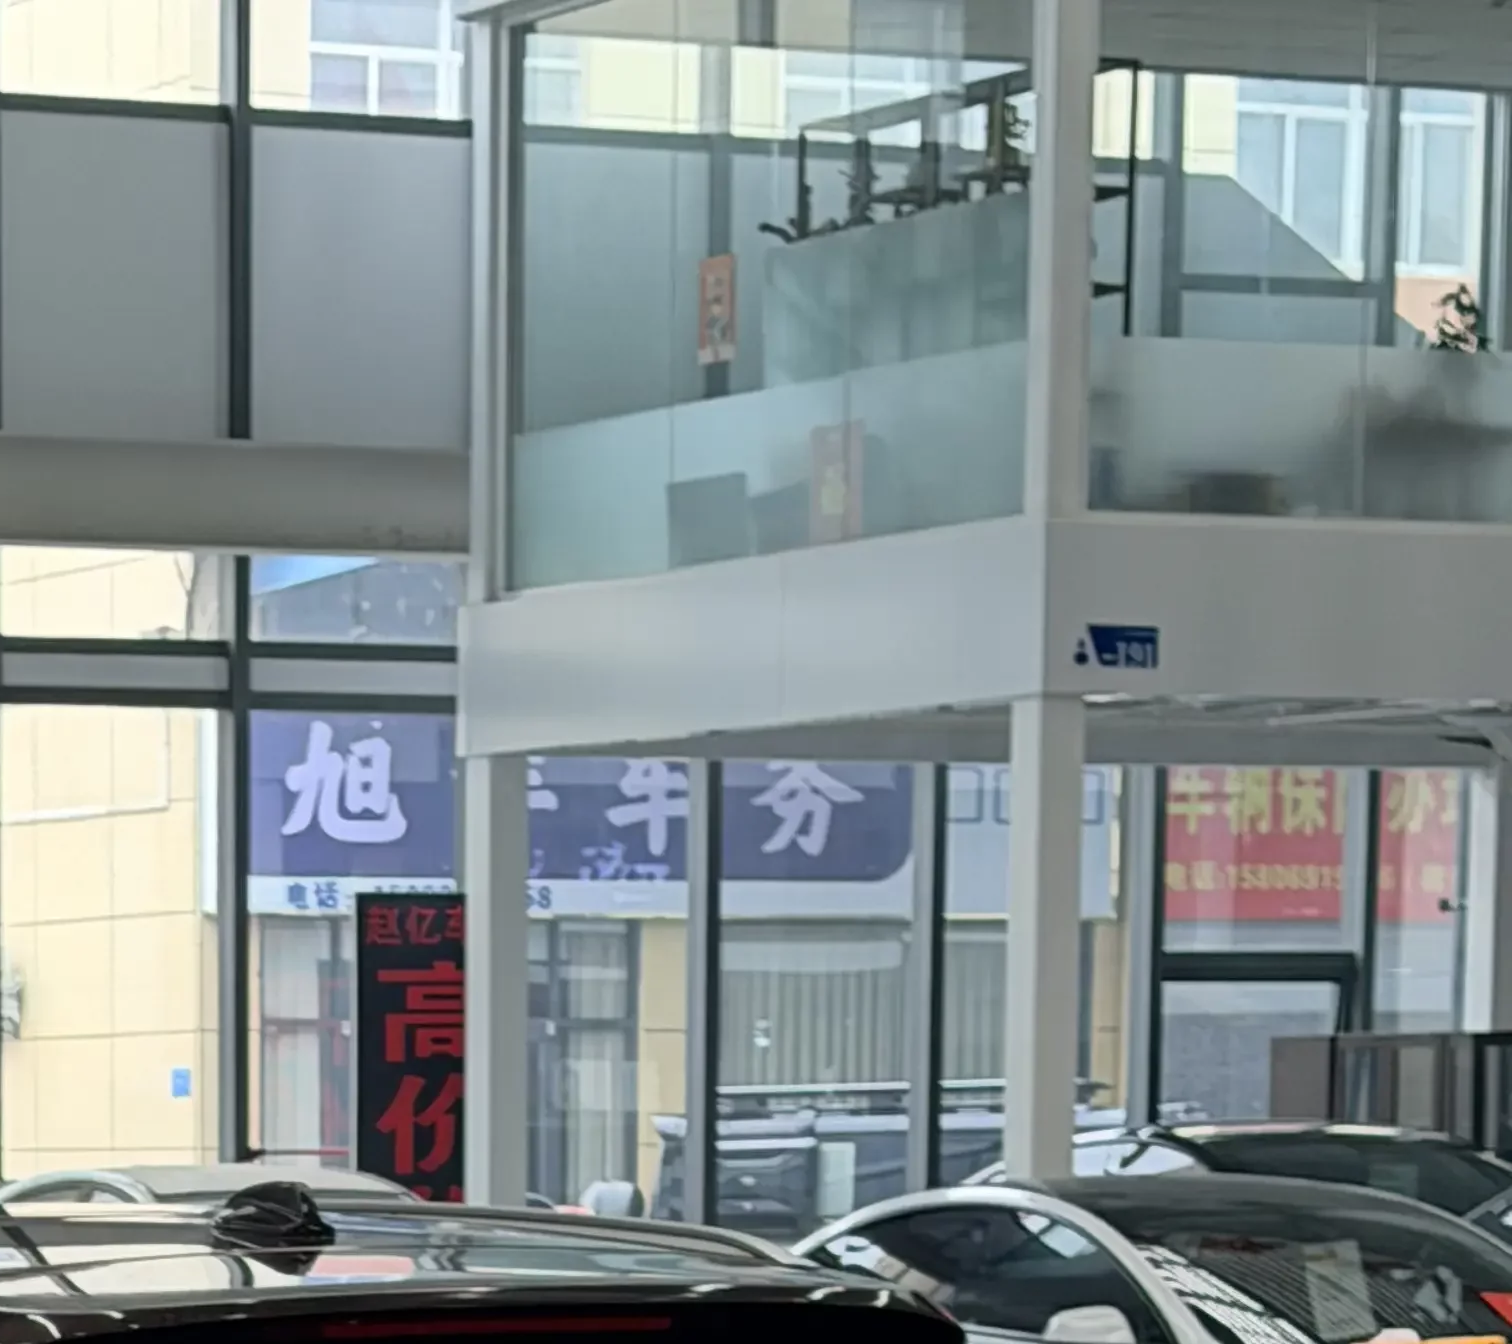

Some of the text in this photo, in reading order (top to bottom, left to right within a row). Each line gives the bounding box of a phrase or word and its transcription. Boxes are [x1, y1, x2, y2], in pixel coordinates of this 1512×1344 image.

[281, 720, 865, 856] 旭车务
[376, 961, 465, 1204] 高价
